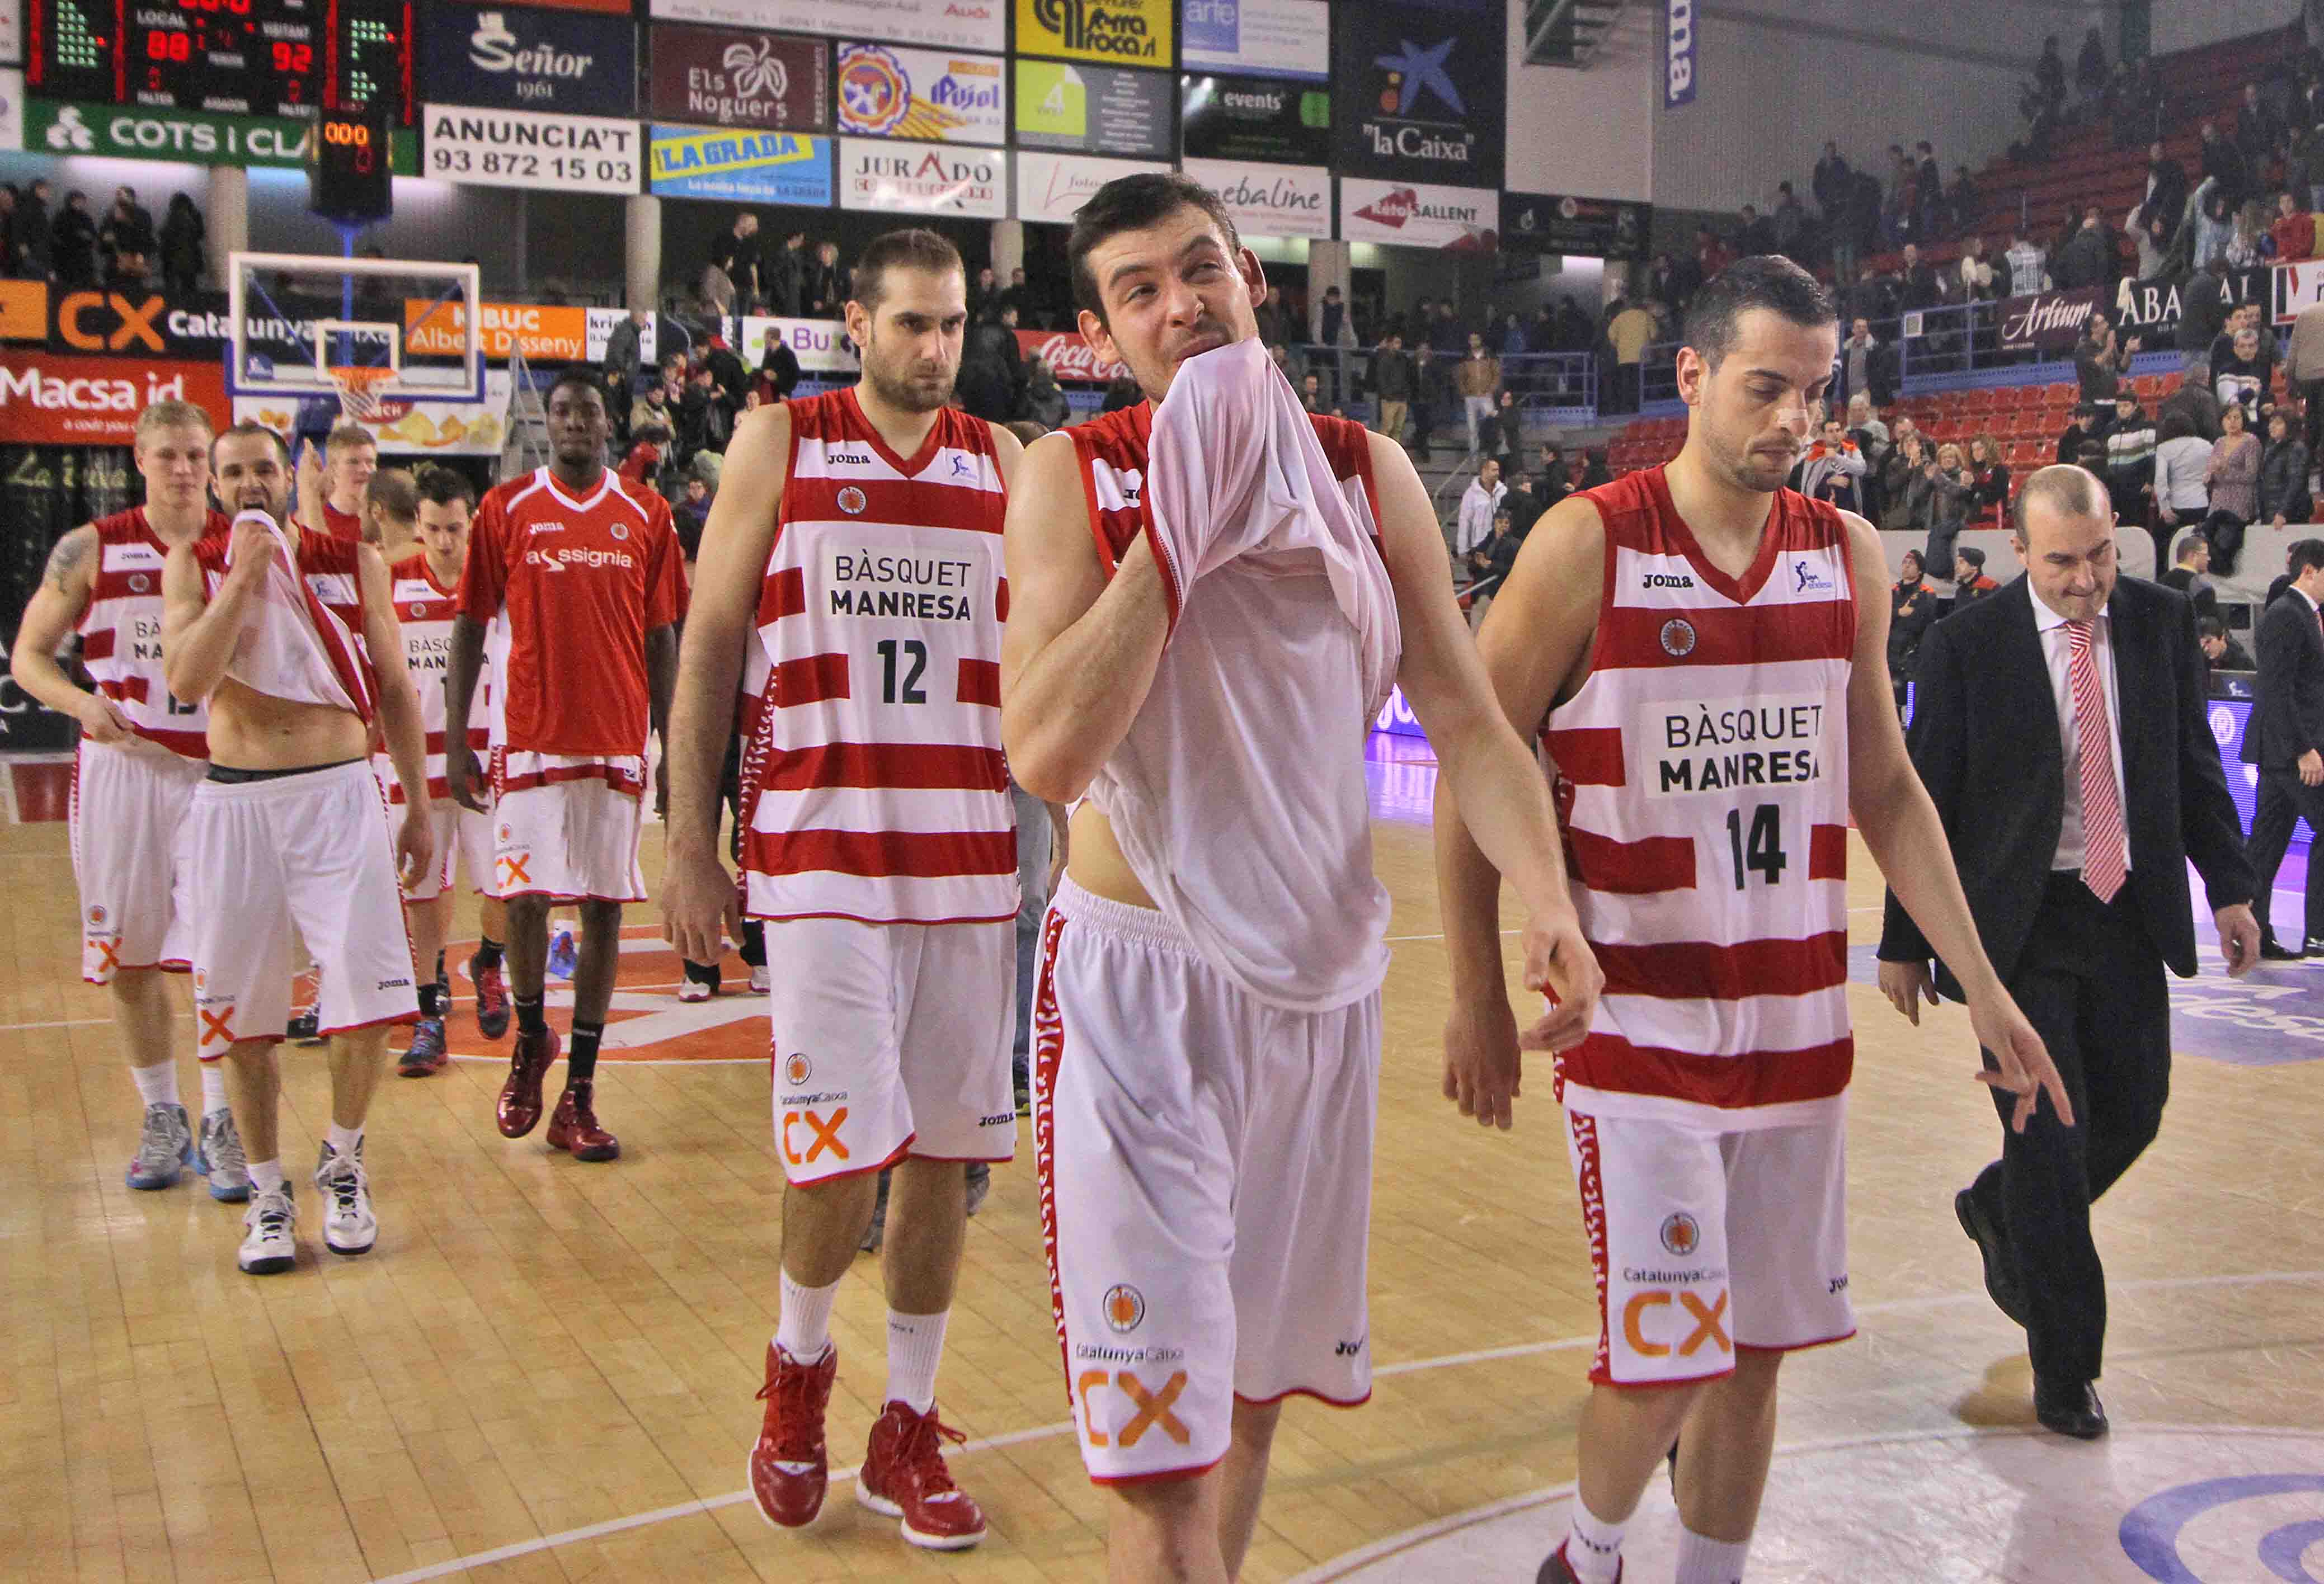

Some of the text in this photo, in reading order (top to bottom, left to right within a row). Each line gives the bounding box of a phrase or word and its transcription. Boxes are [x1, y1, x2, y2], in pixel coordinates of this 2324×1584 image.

[468, 22, 593, 78] Señor
[688, 67, 726, 92] Els
[688, 91, 788, 124] Noguers
[1224, 92, 1282, 111] events
[110, 116, 217, 153] COTS
[434, 116, 632, 153] ANUNCIA'T
[662, 134, 799, 171] LA GRADA
[434, 148, 633, 183] 93 872 15 03
[855, 150, 993, 183] JURADO
[1223, 175, 1323, 210] ebaline
[59, 291, 166, 352] CX
[168, 309, 392, 346] Cataunyaixa
[411, 326, 582, 359] Albet Dsseny
[0, 365, 136, 411] Macsa
[836, 548, 972, 587] BÀSQUET
[831, 590, 971, 621] MANRESA
[877, 639, 926, 704] 12
[1666, 704, 1822, 749] BÀSQUET
[1659, 750, 1819, 793] MANRESA
[1726, 804, 1786, 892] 14
[783, 1106, 850, 1165] CX
[1622, 1288, 1731, 1357] CX
[1078, 1369, 1191, 1447] CX
